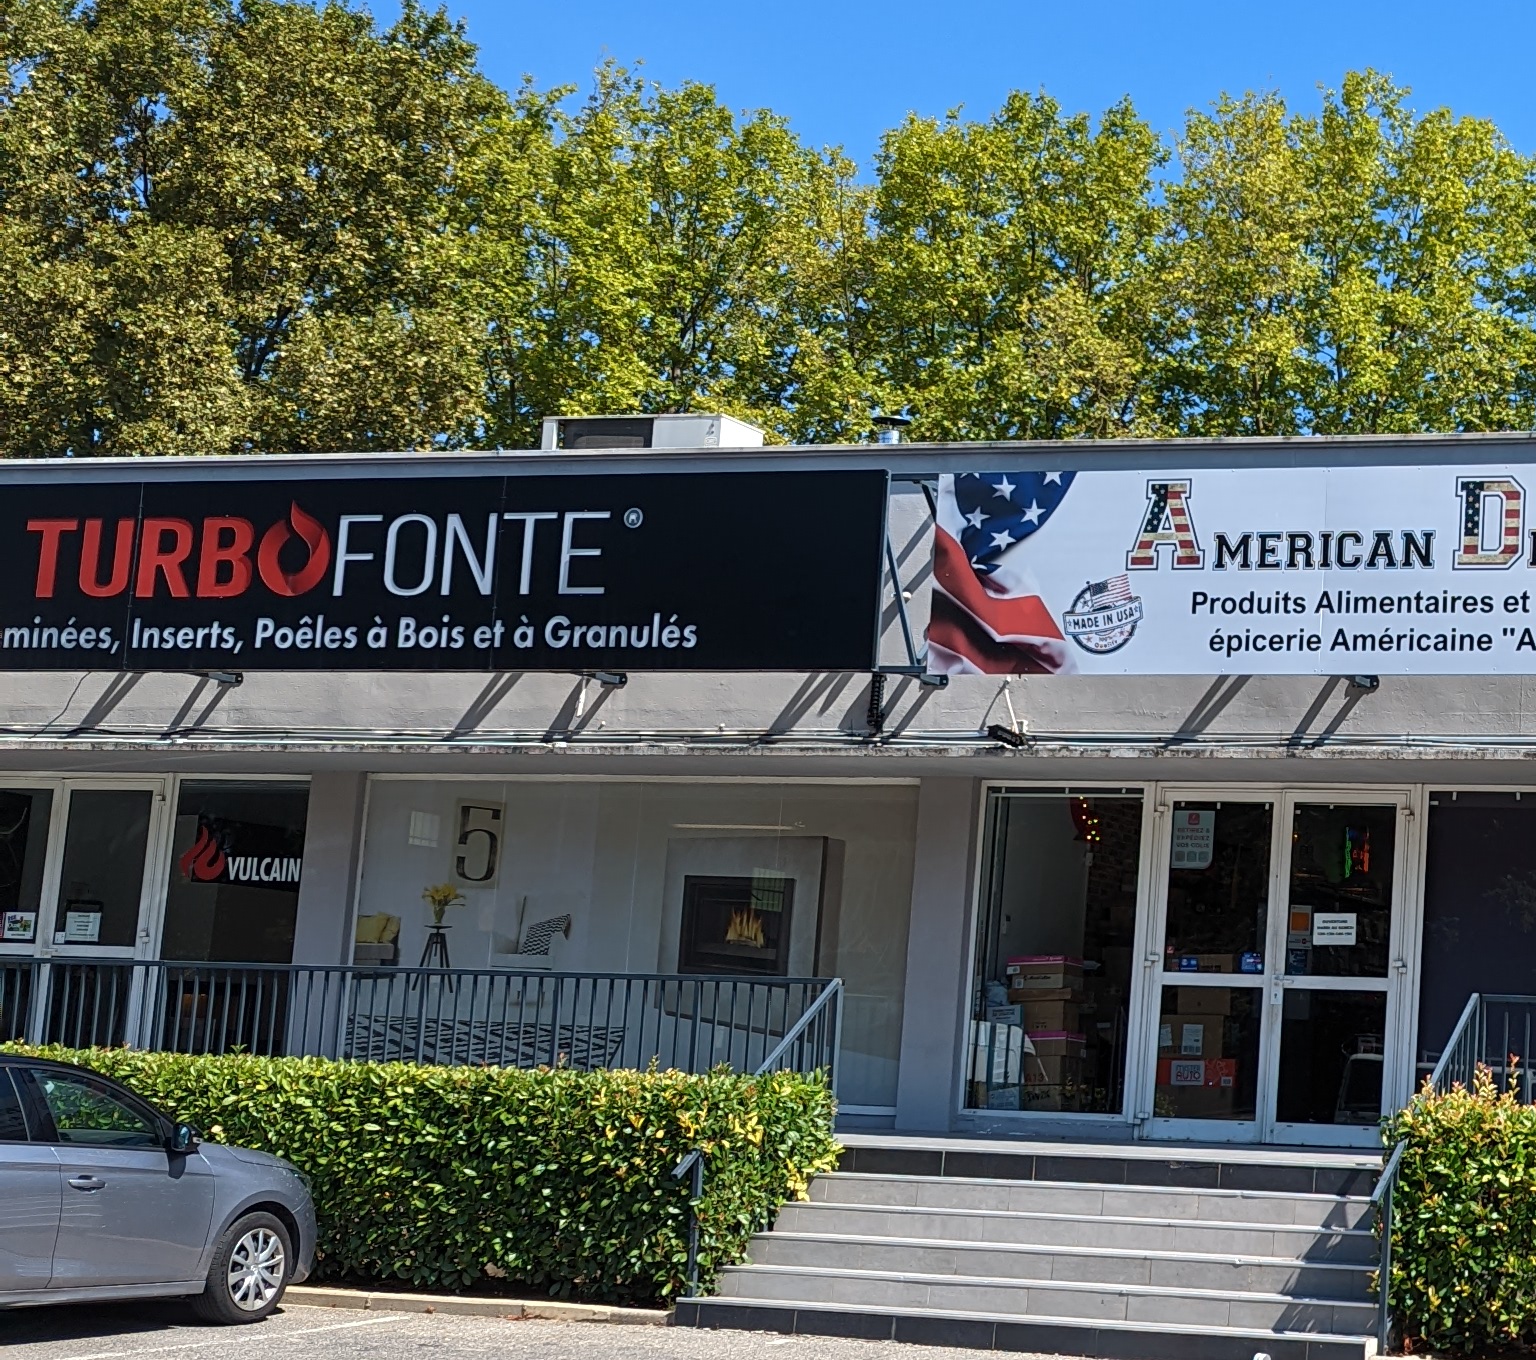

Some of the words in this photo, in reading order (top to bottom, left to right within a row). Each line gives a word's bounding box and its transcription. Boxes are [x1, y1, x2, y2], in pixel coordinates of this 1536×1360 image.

[1191, 591, 1306, 615] Produits
[1314, 589, 1494, 615] Alimentaires
[1503, 590, 1530, 614] et
[1073, 616, 1099, 630] MADE
[1103, 612, 1113, 626] IN
[1116, 606, 1135, 622] USA
[0, 615, 120, 654] minées,
[131, 617, 243, 654] Inserts,
[254, 614, 358, 649] Poêles
[366, 615, 388, 648] à
[397, 614, 465, 649] Bois
[473, 619, 505, 648] et
[513, 614, 534, 648] à
[544, 612, 698, 649] Granulés
[1209, 628, 1322, 658] épicerie
[1330, 627, 1493, 652] Américaine
[456, 805, 502, 882] 5
[227, 856, 301, 883] VULCAIN
